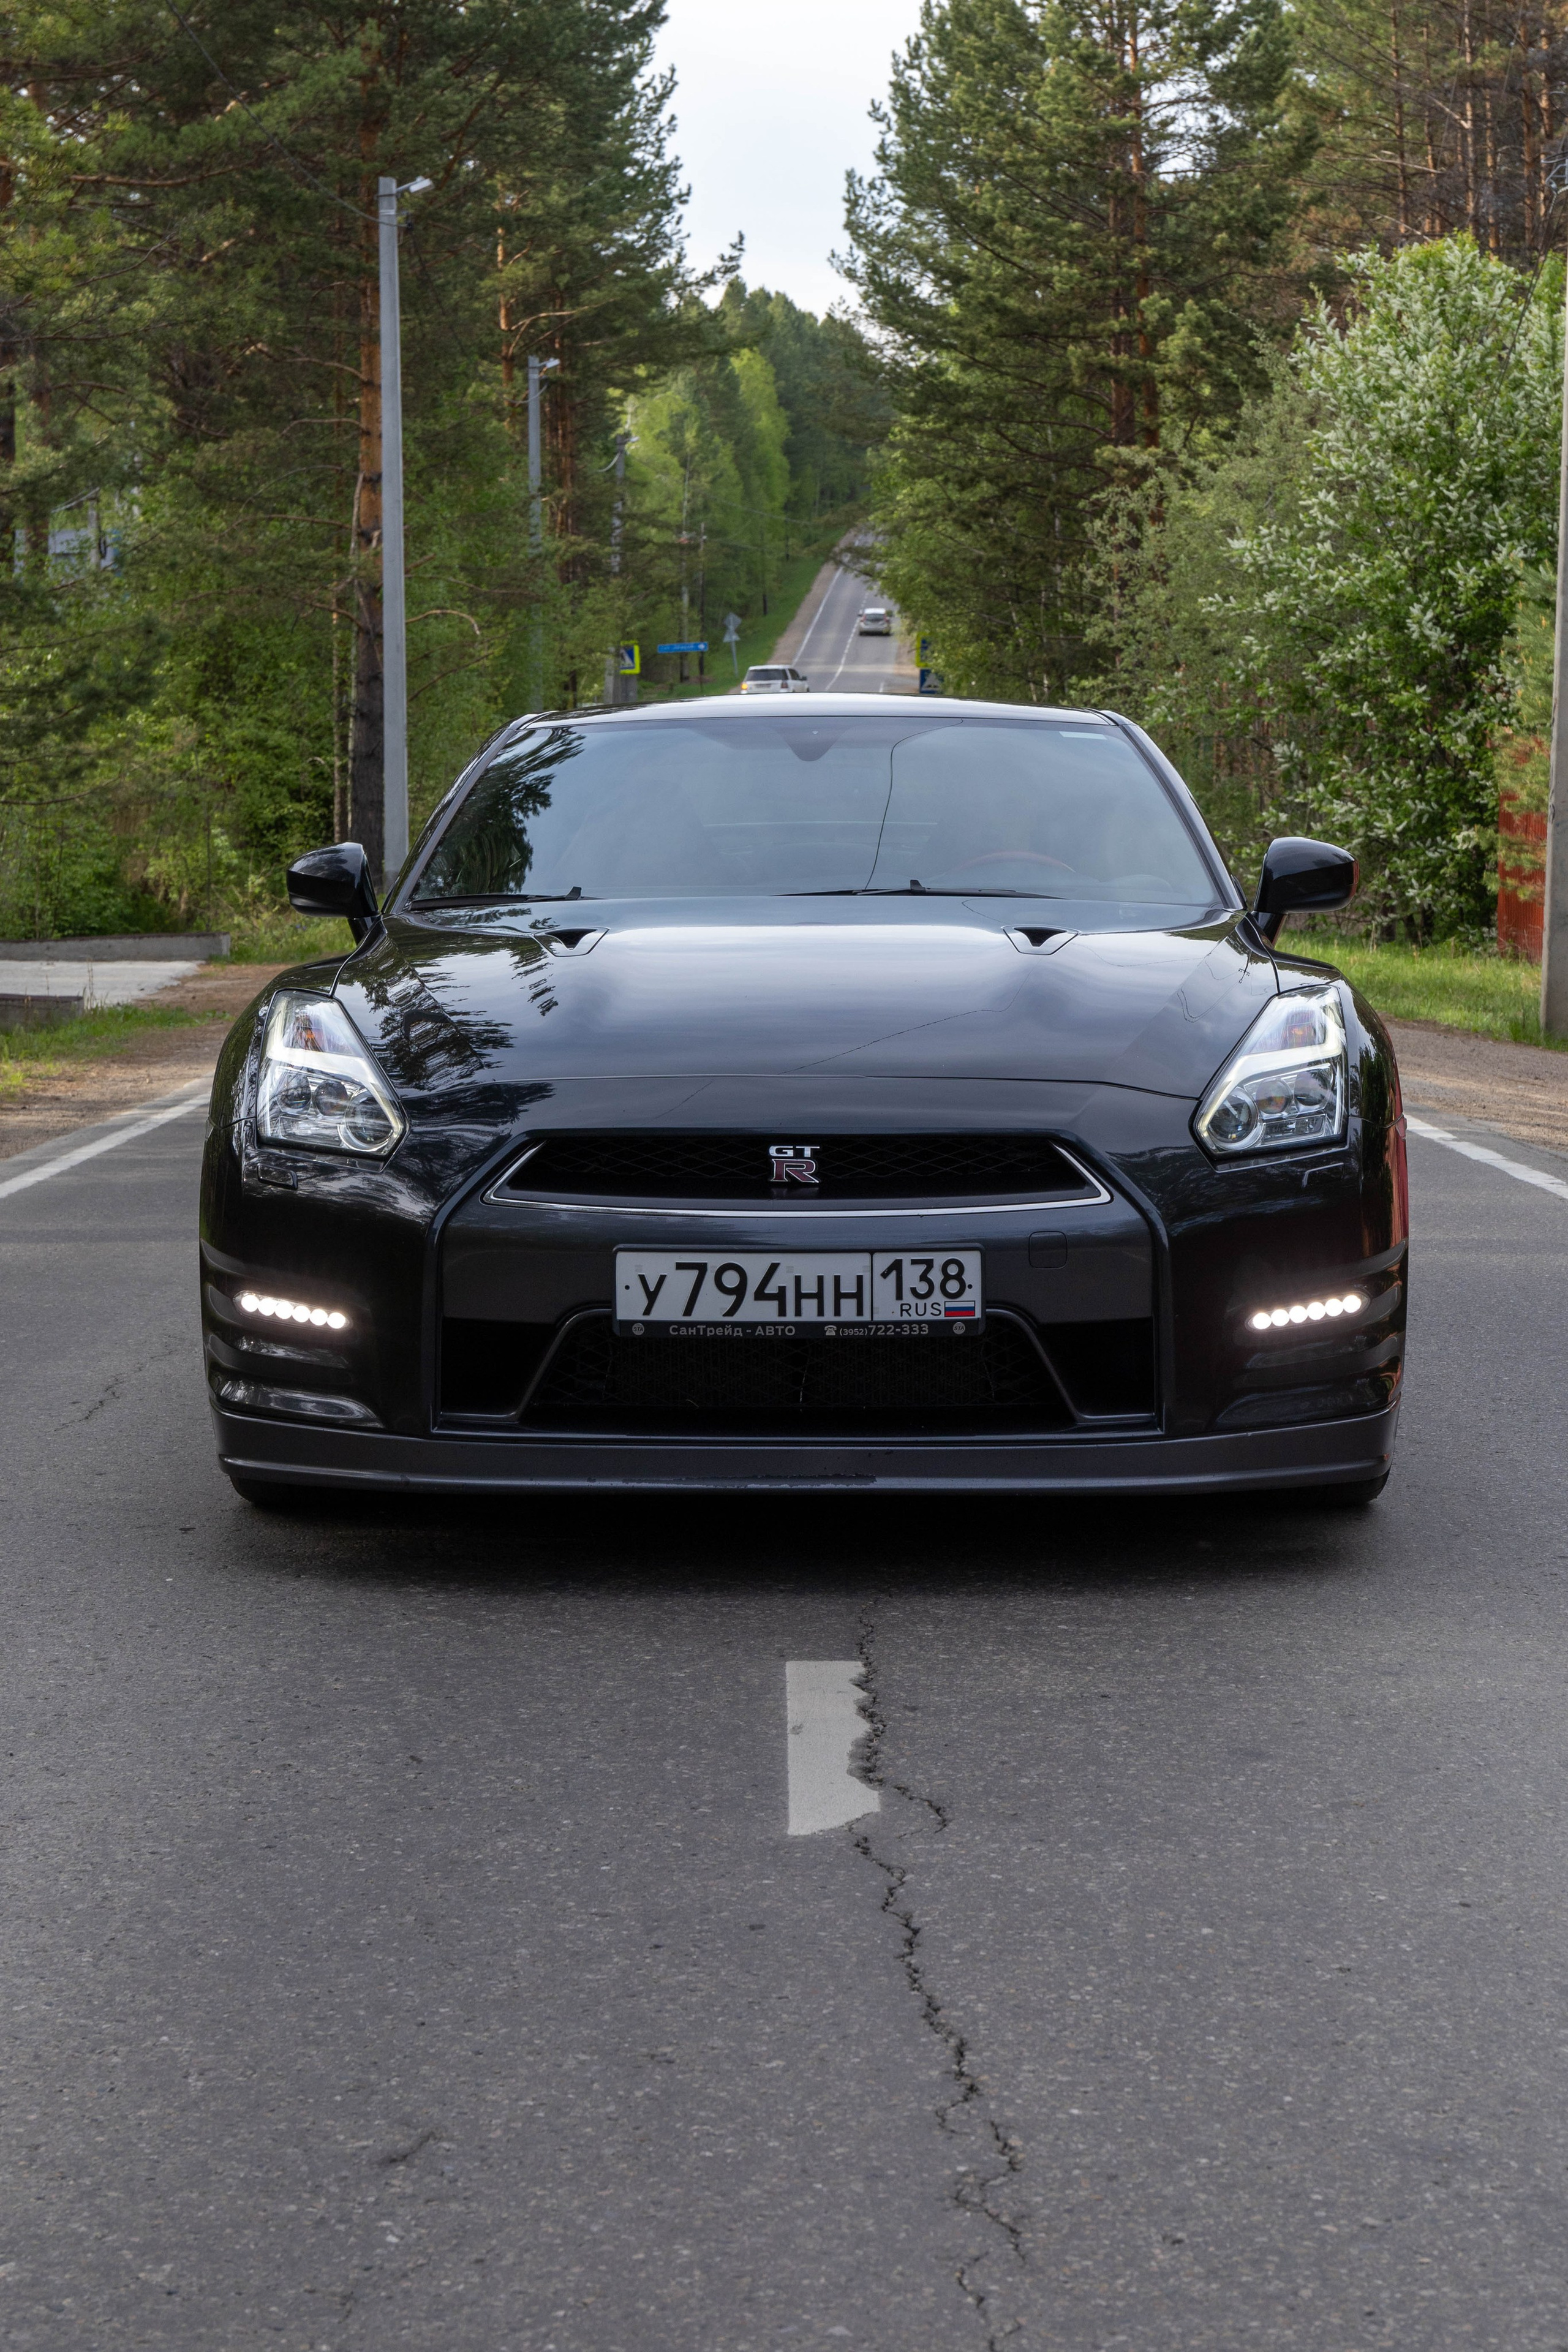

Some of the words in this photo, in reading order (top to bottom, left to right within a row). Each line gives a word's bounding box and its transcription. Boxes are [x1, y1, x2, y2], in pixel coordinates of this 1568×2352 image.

[769, 1145, 820, 1158] GT
[770, 1158, 820, 1183] R
[880, 1257, 966, 1301] 138
[900, 1302, 942, 1317] RUS
[669, 1324, 743, 1336] СанТрейд
[755, 1325, 796, 1336] АВТО
